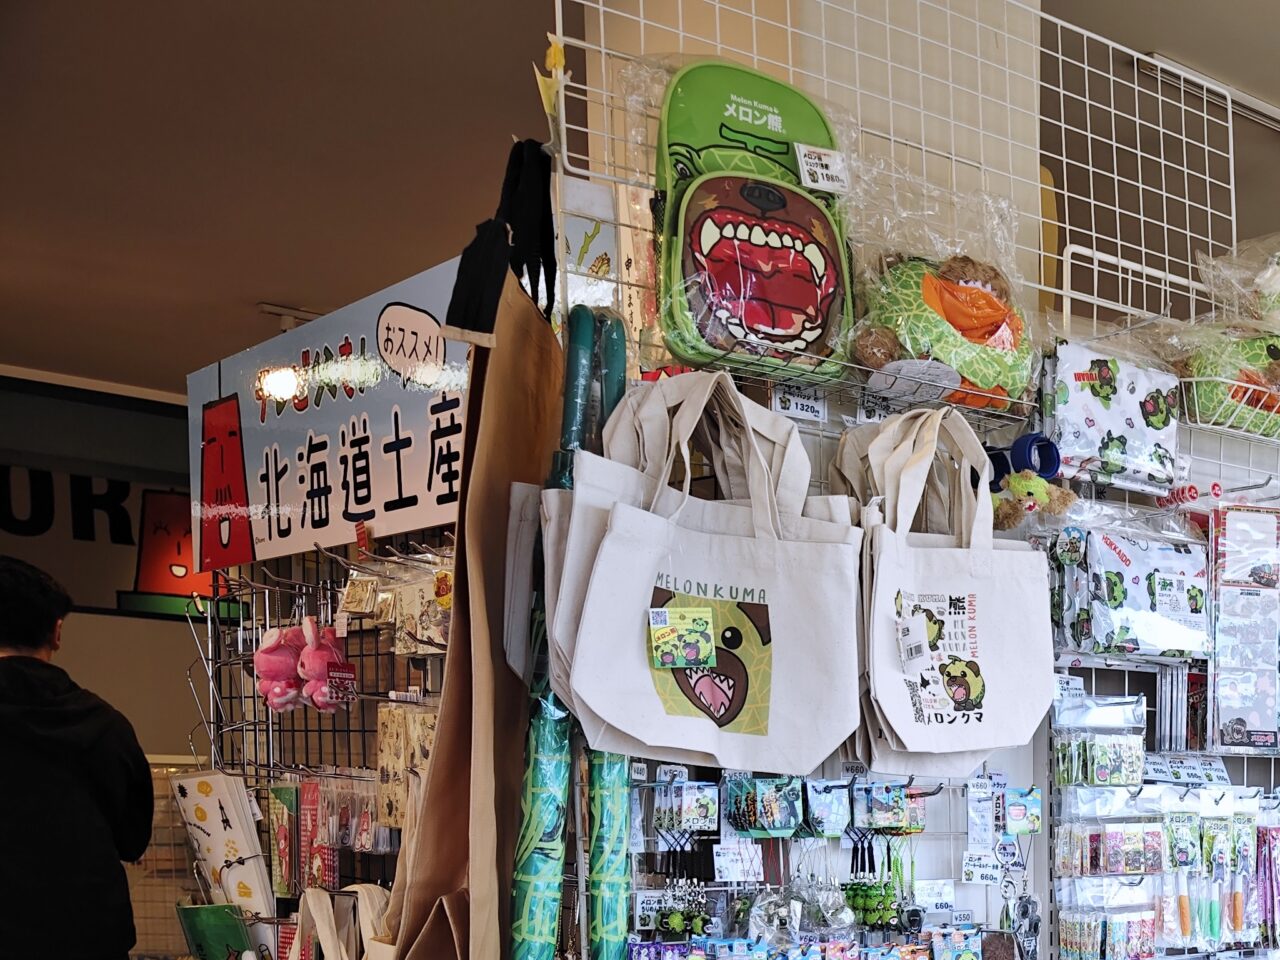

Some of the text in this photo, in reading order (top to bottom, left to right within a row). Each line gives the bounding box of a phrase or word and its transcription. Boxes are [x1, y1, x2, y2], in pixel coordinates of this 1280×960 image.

[724, 103, 782, 132] メロン熊
[384, 323, 439, 361] おススメ!
[260, 391, 461, 541] 北海道土産
[1101, 534, 1131, 567] HOKKAIDO
[948, 594, 966, 615] 熊
[967, 593, 979, 658] MELON KUMA
[845, 766, 865, 774] ¥660
